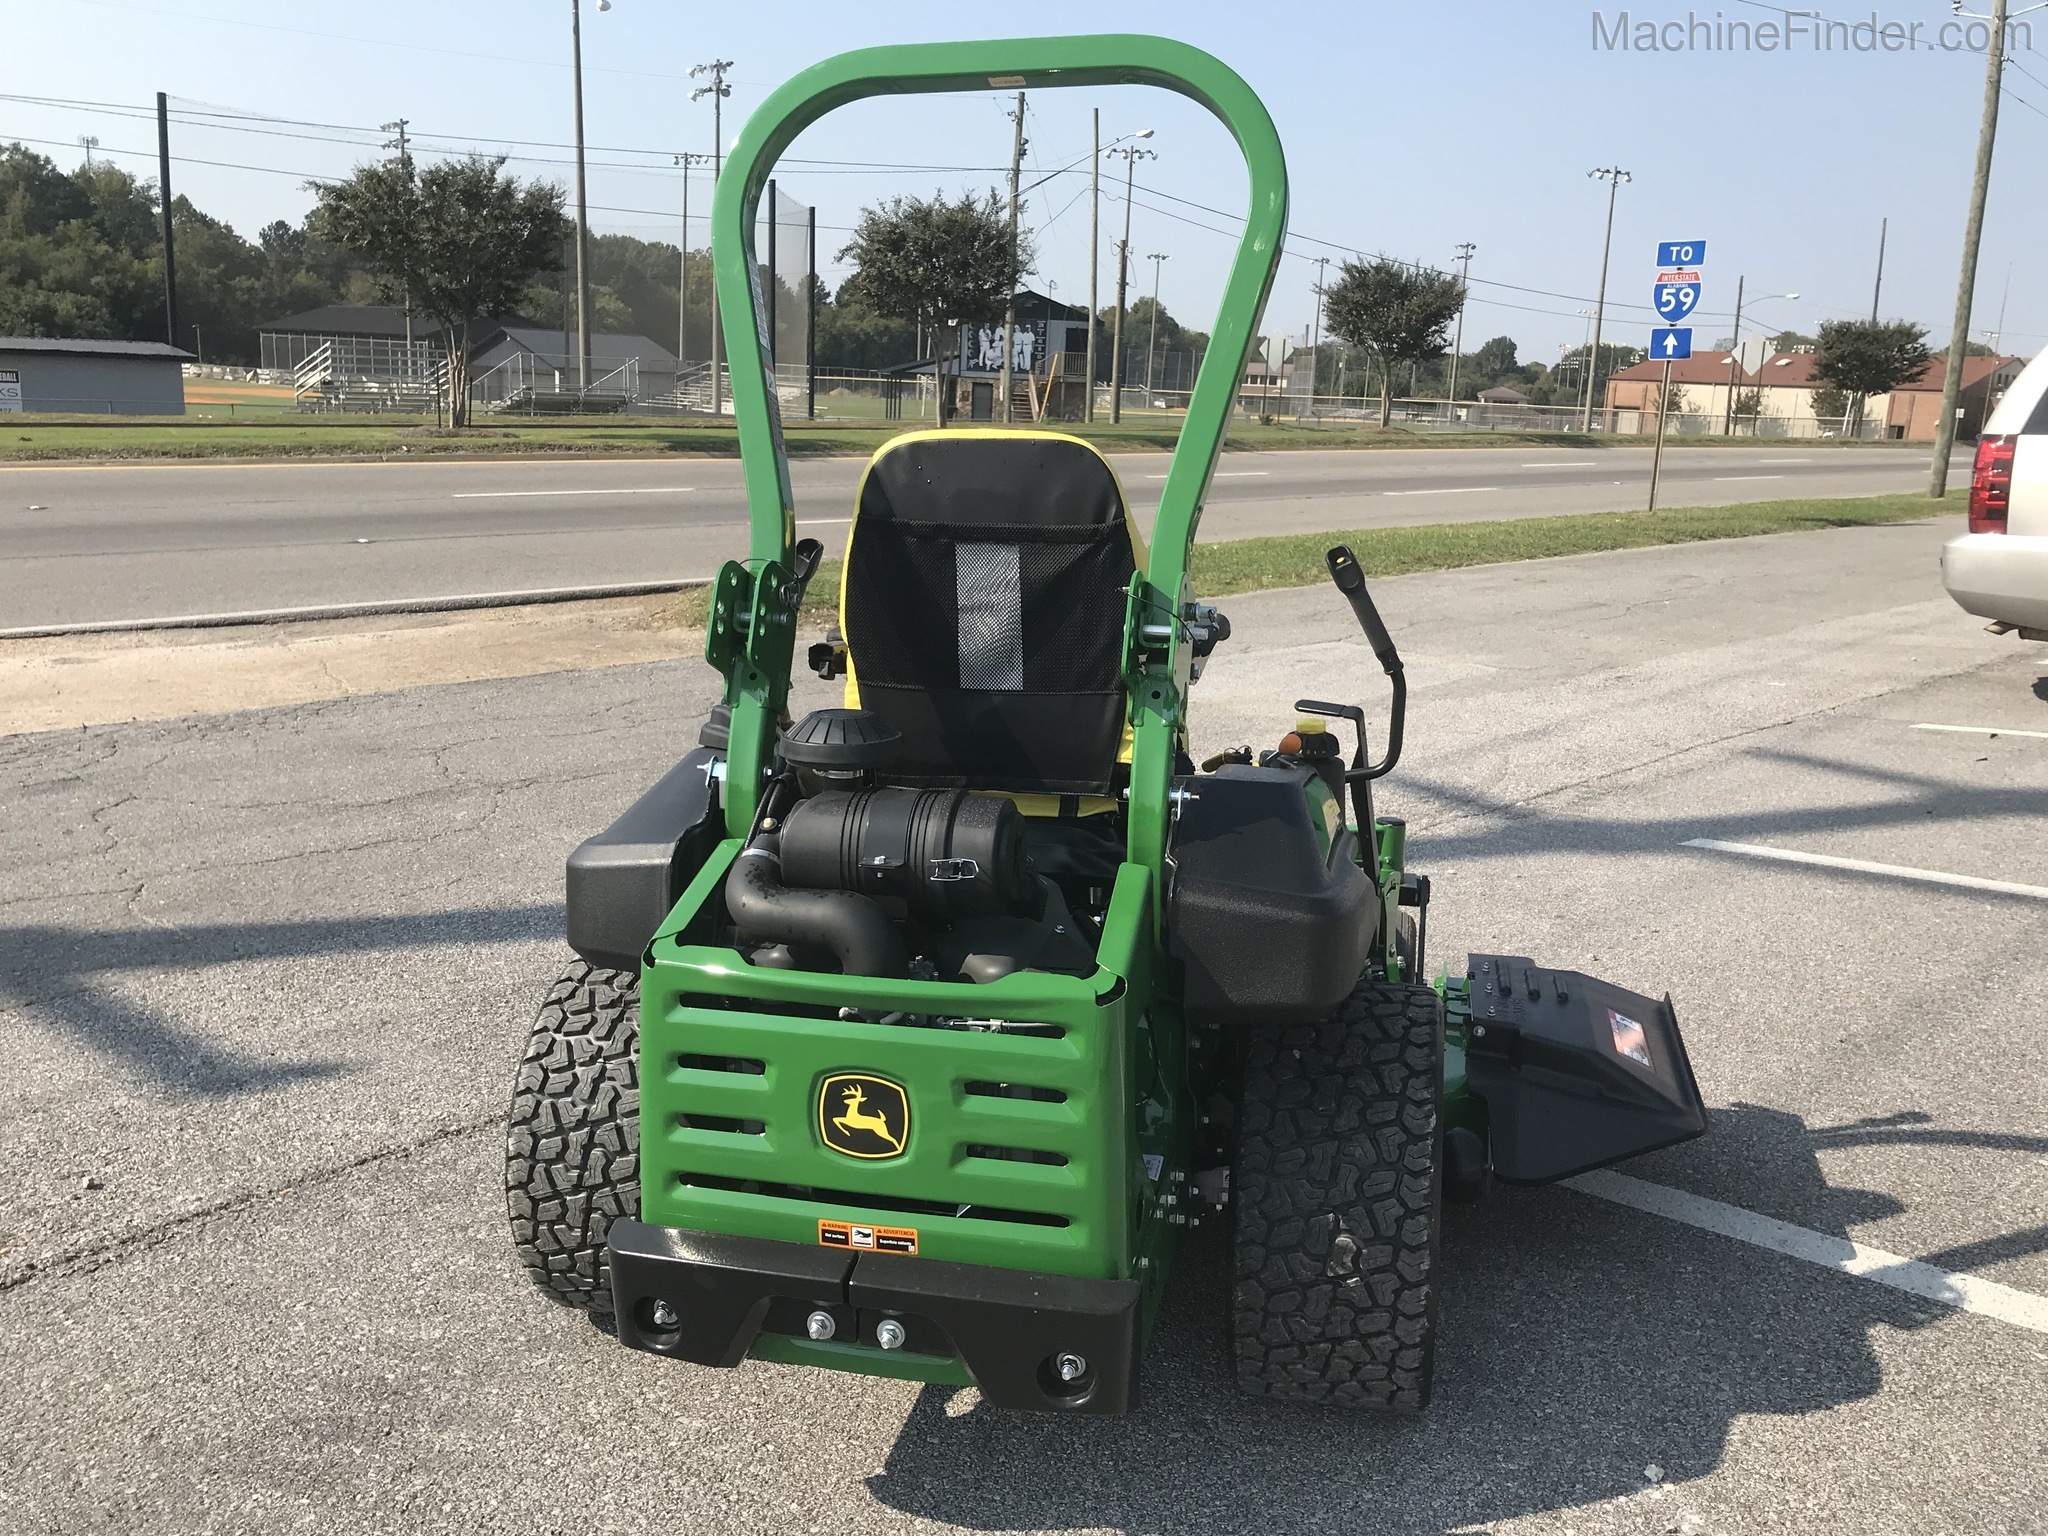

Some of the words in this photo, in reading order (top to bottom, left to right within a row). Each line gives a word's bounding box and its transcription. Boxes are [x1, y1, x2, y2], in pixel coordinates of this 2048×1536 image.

[1670, 246, 1693, 261] TO
[1661, 273, 1696, 282] INTERSTATE
[1660, 287, 1695, 313] 59
